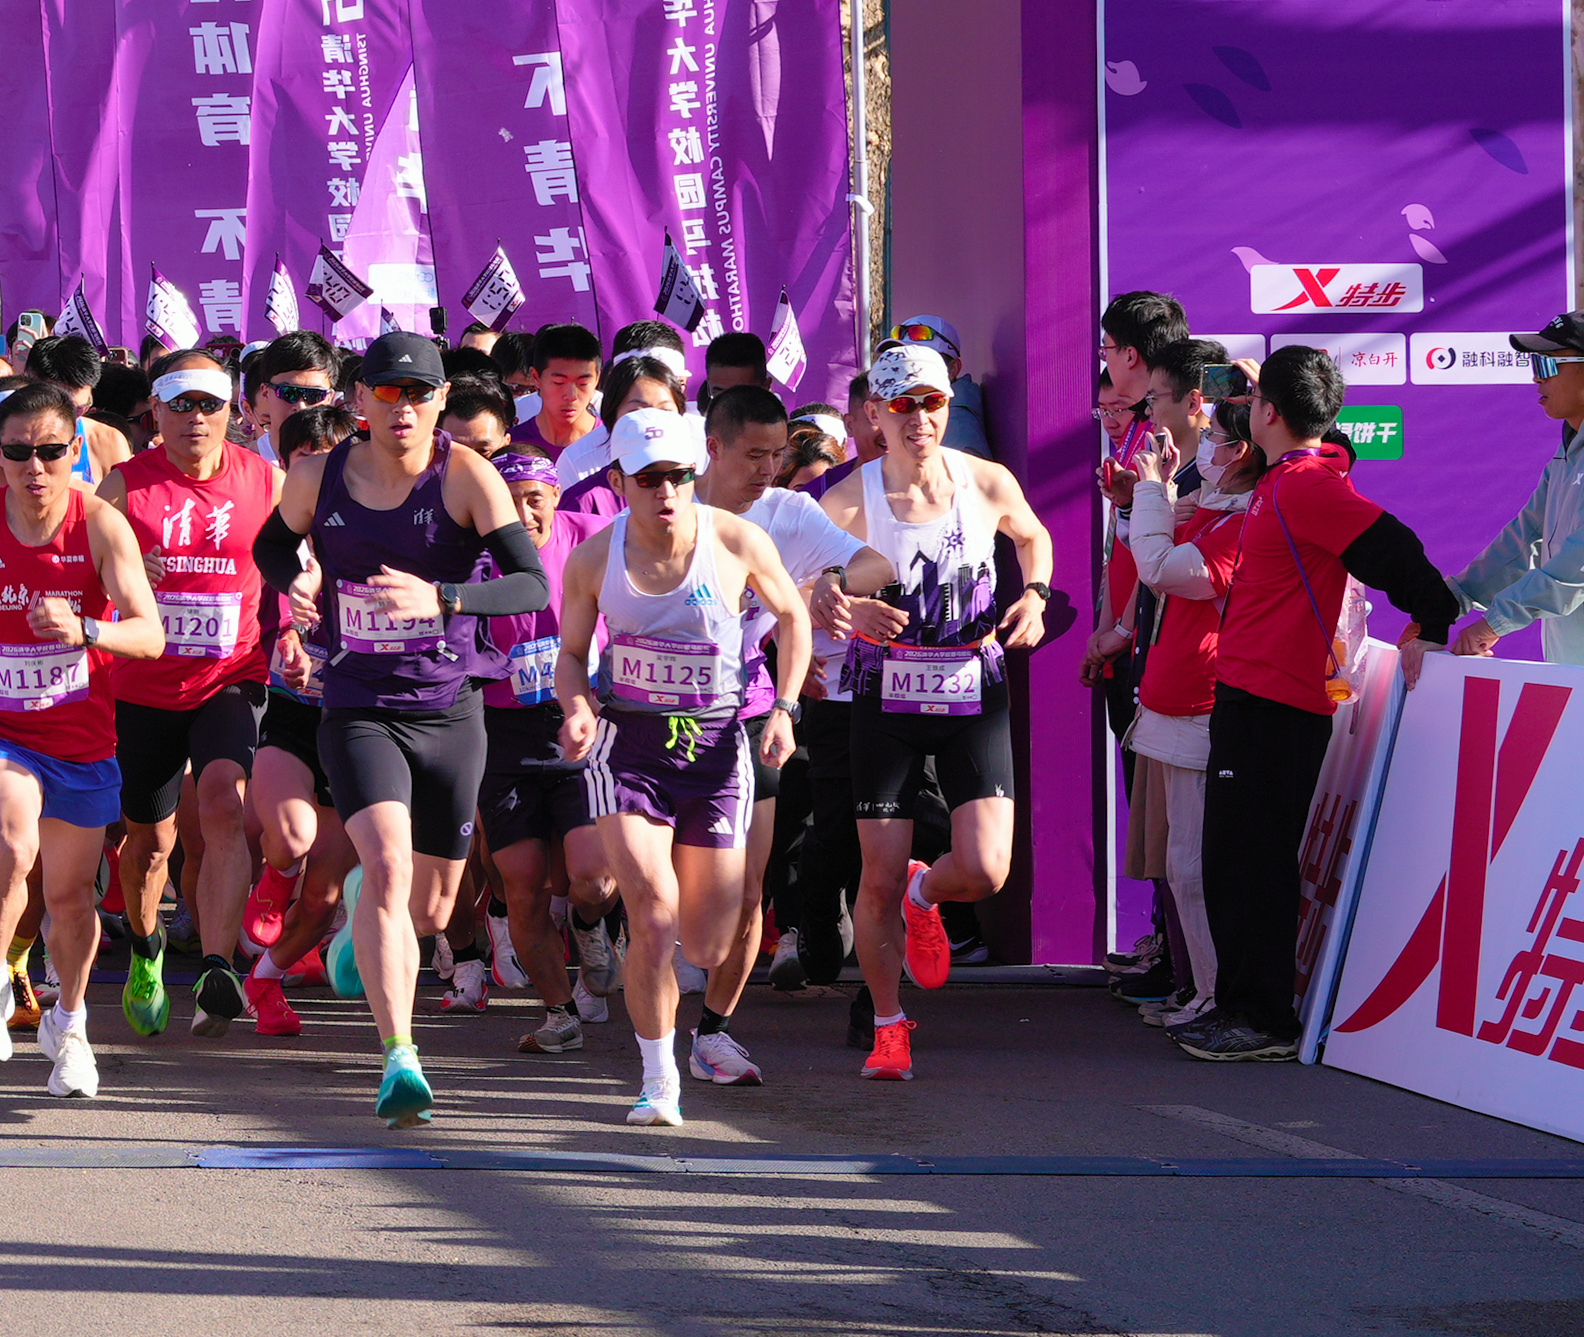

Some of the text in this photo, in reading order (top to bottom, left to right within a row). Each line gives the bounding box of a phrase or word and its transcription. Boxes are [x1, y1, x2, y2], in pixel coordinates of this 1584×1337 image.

[1334, 282, 1408, 307] 特步
[1350, 352, 1399, 368] 凉白开
[45, 590, 84, 598] MARATHON
[623, 657, 712, 685] M1125
[892, 672, 976, 694] M1232
